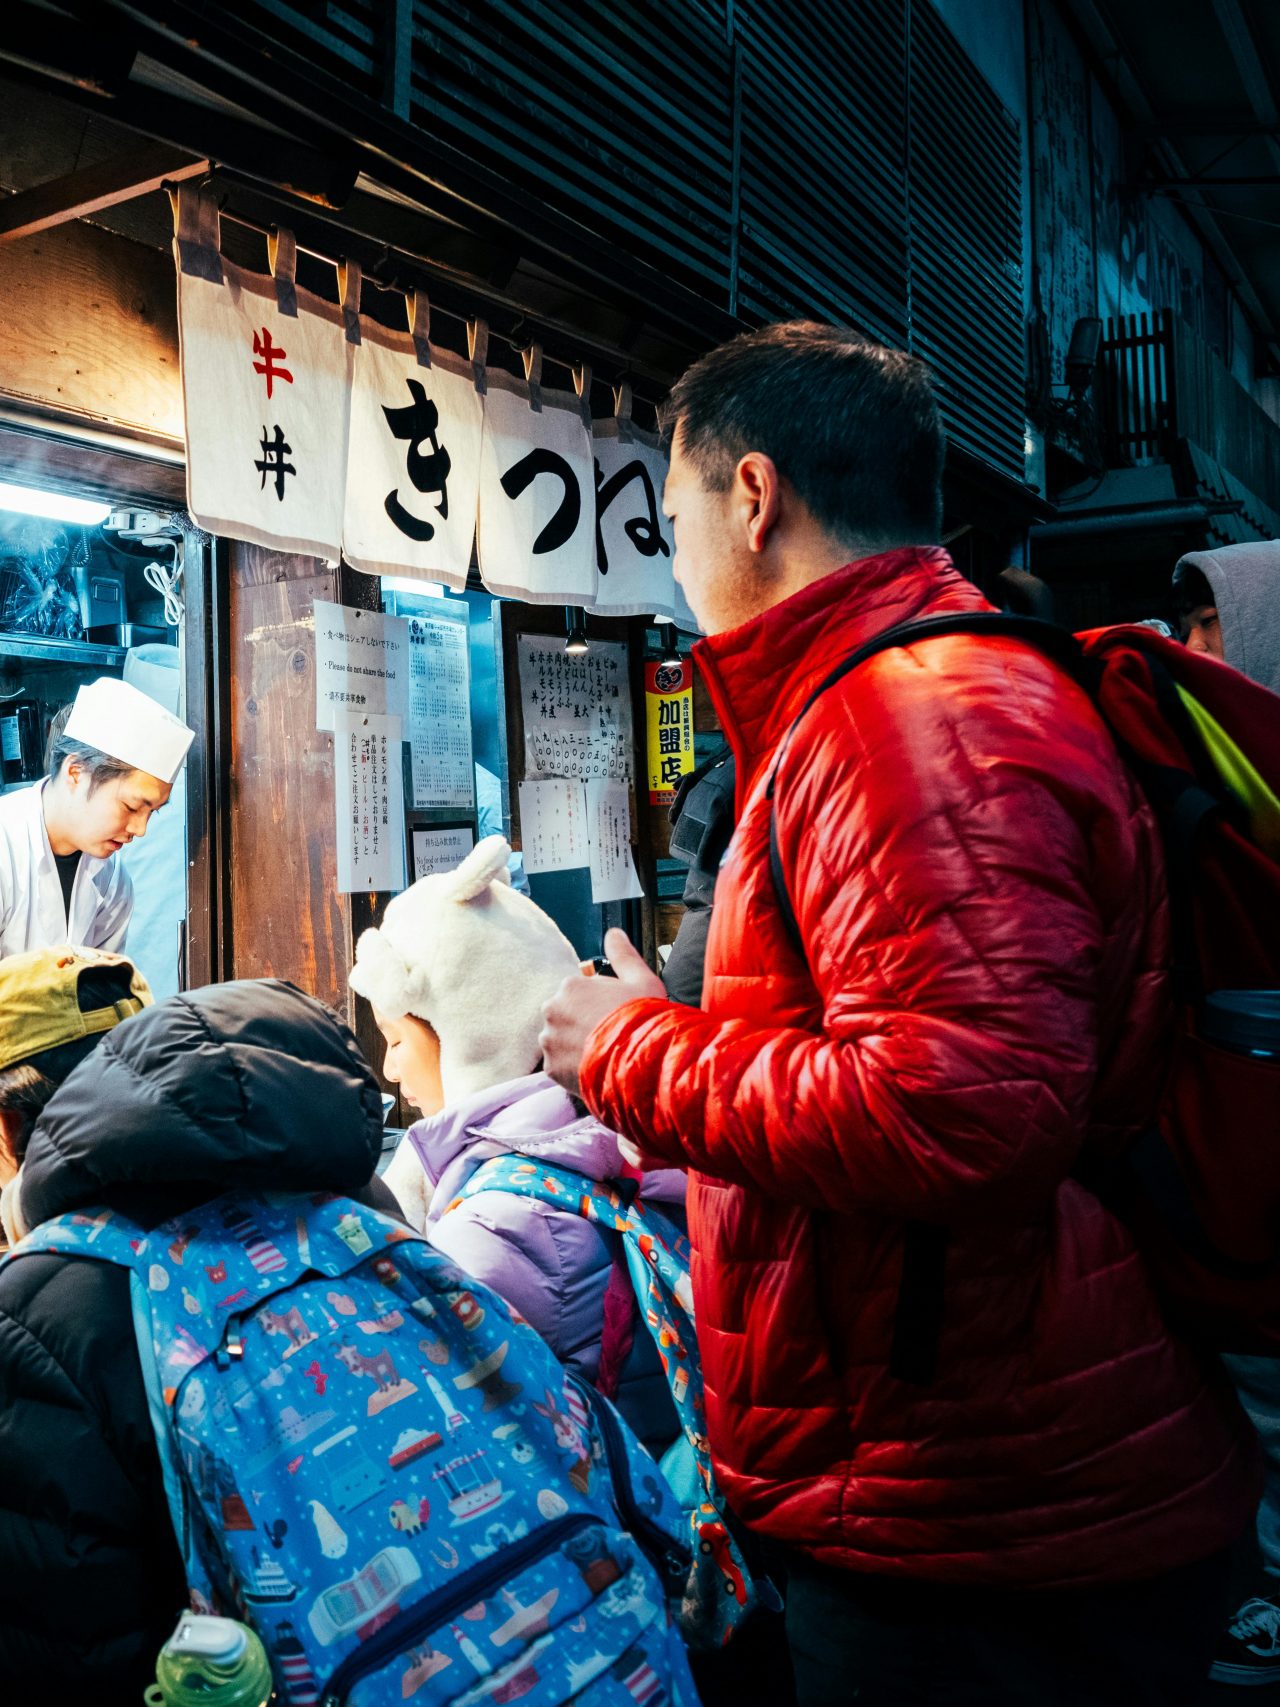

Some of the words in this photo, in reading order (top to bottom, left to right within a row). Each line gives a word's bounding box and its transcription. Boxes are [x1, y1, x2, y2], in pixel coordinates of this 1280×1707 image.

[253, 327, 297, 502] 牛丼
[328, 660, 345, 671] Please
[346, 663, 353, 672] do
[353, 665, 362, 674] not
[362, 666, 376, 677] share
[377, 668, 386, 678] the
[385, 669, 396, 680] food
[538, 651, 548, 718] ホルモン丼
[658, 699, 682, 784] 加盟店
[423, 855, 434, 864] food
